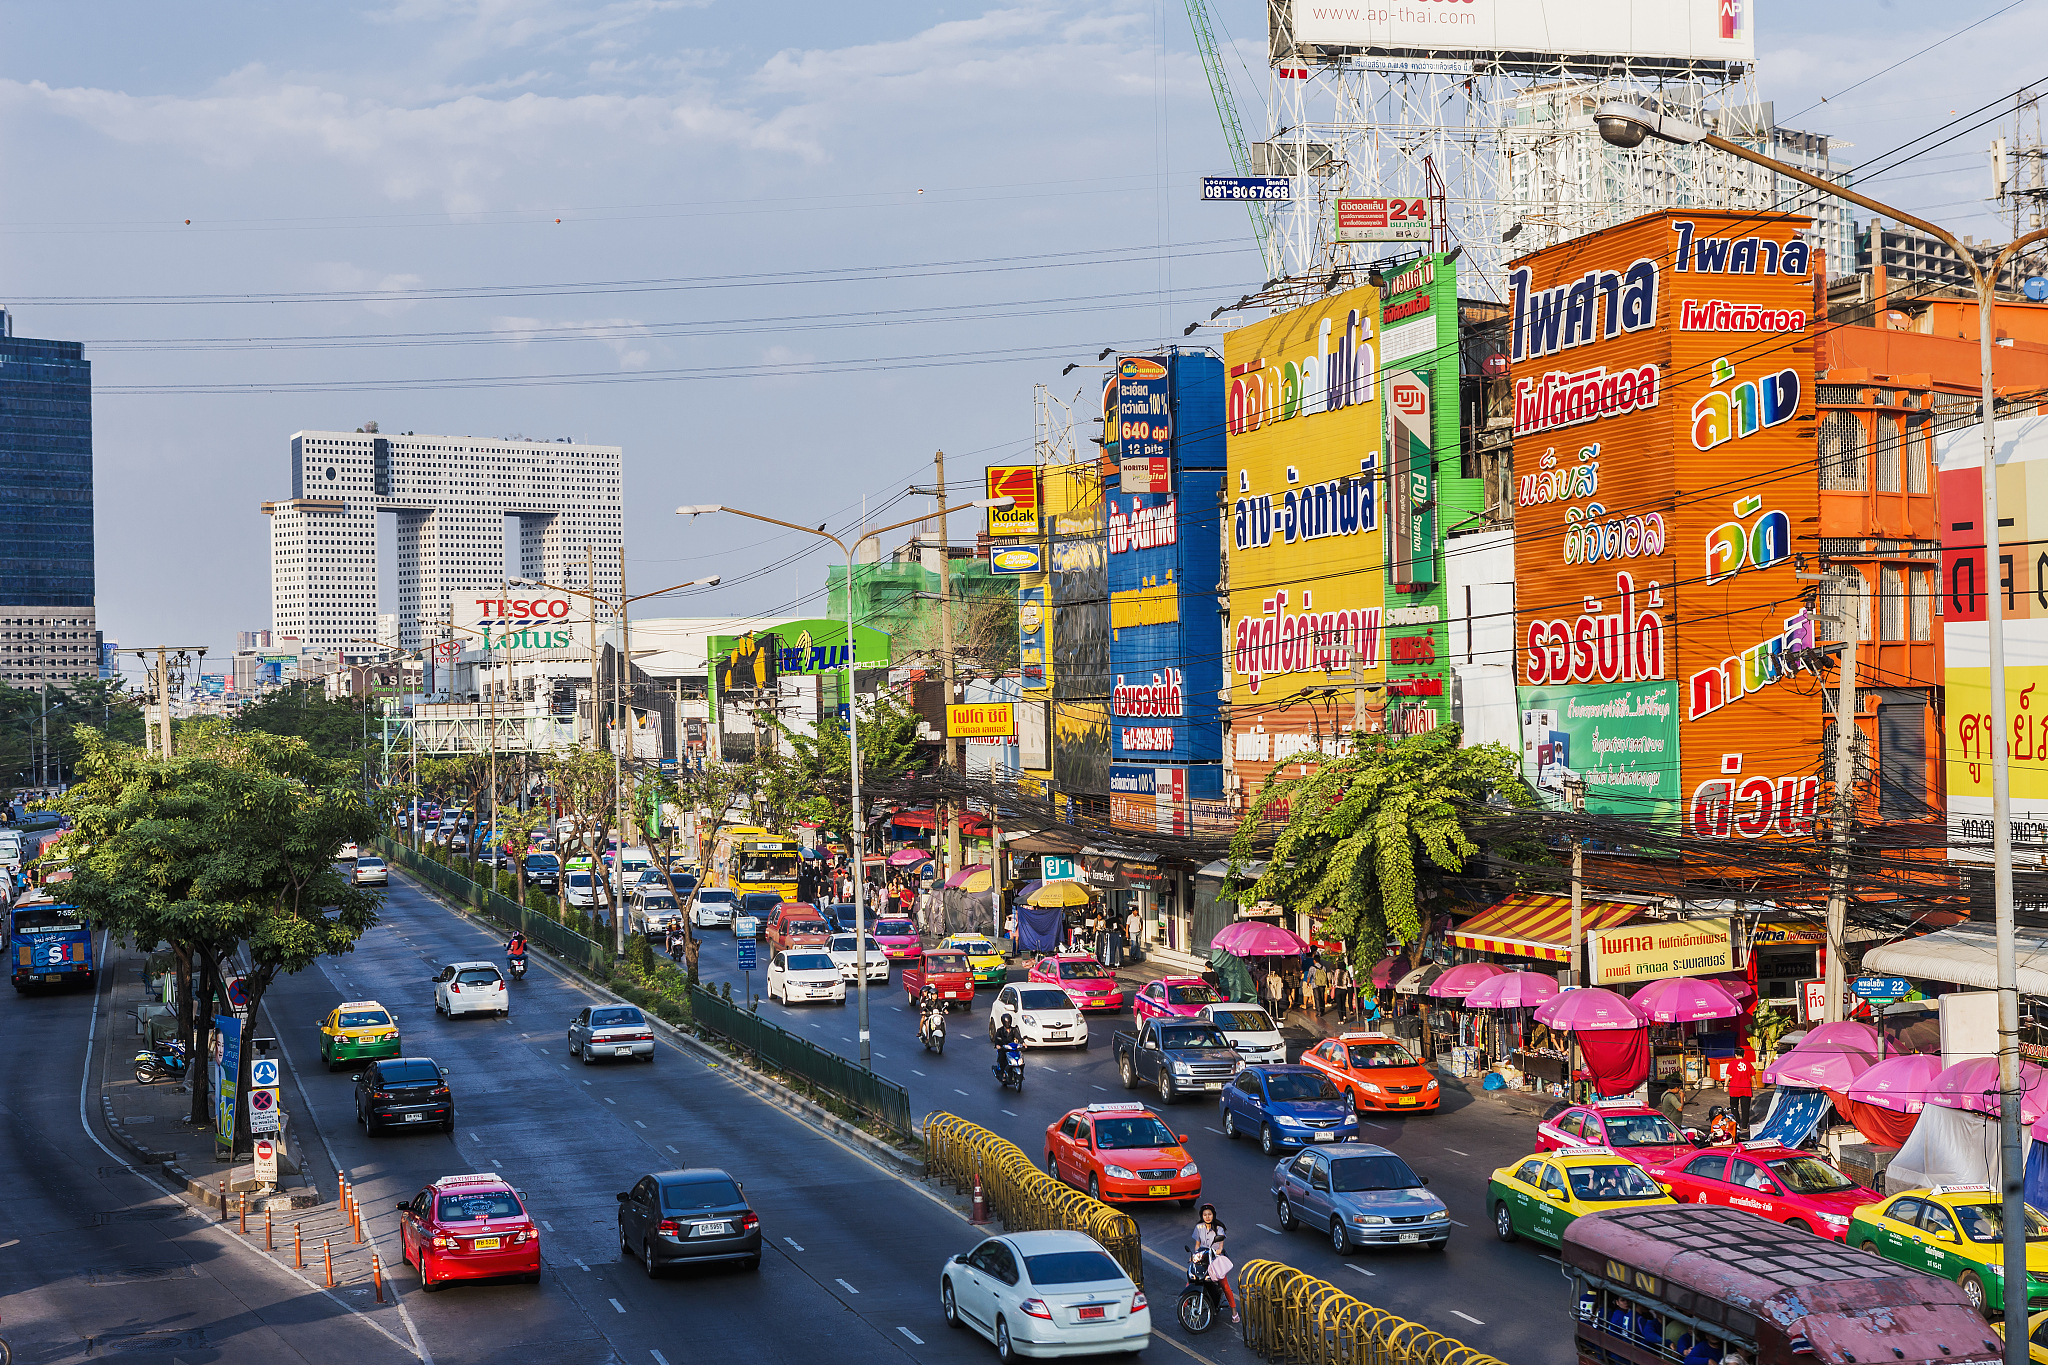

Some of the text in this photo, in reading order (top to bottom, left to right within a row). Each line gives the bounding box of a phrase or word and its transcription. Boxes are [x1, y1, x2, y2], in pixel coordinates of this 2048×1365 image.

[1312, 6, 1476, 25] www.ap-thai.com
[1389, 199, 1426, 220] 24
[1672, 220, 1811, 276] ไพศาล
[1510, 258, 1660, 363] ไพศาล
[1679, 299, 1807, 334] โฟโต้ดิจิตอล
[1121, 382, 1149, 396] ละเอียด
[1513, 363, 1660, 437] โฟโต้ดิจิตอล
[1121, 400, 1149, 415] กว่าเดิม
[1149, 393, 1160, 415] 100
[1691, 356, 1801, 451] ล้าง
[1122, 421, 1168, 442] 640 dpi
[1128, 443, 1164, 455] 12 bits
[1519, 442, 1601, 508] แล็บสี
[993, 509, 1035, 523] Kodak
[1563, 501, 1666, 566] ดิจิตอล
[1705, 493, 1791, 587] อัด
[475, 599, 569, 618] TESCO
[481, 625, 570, 650] Lotus
[1526, 571, 1665, 686] รอรับได้
[1138, 773, 1149, 792] 100
[1690, 753, 1818, 839] ด่วน
[1046, 859, 1073, 877] ยา
[1601, 935, 1654, 955] ไพศาล
[1605, 952, 1726, 978] ภาพสี ดิจิตอล ระบบเลเซอร์
[1891, 980, 1904, 991] 22
[219, 1101, 234, 1137] 16
